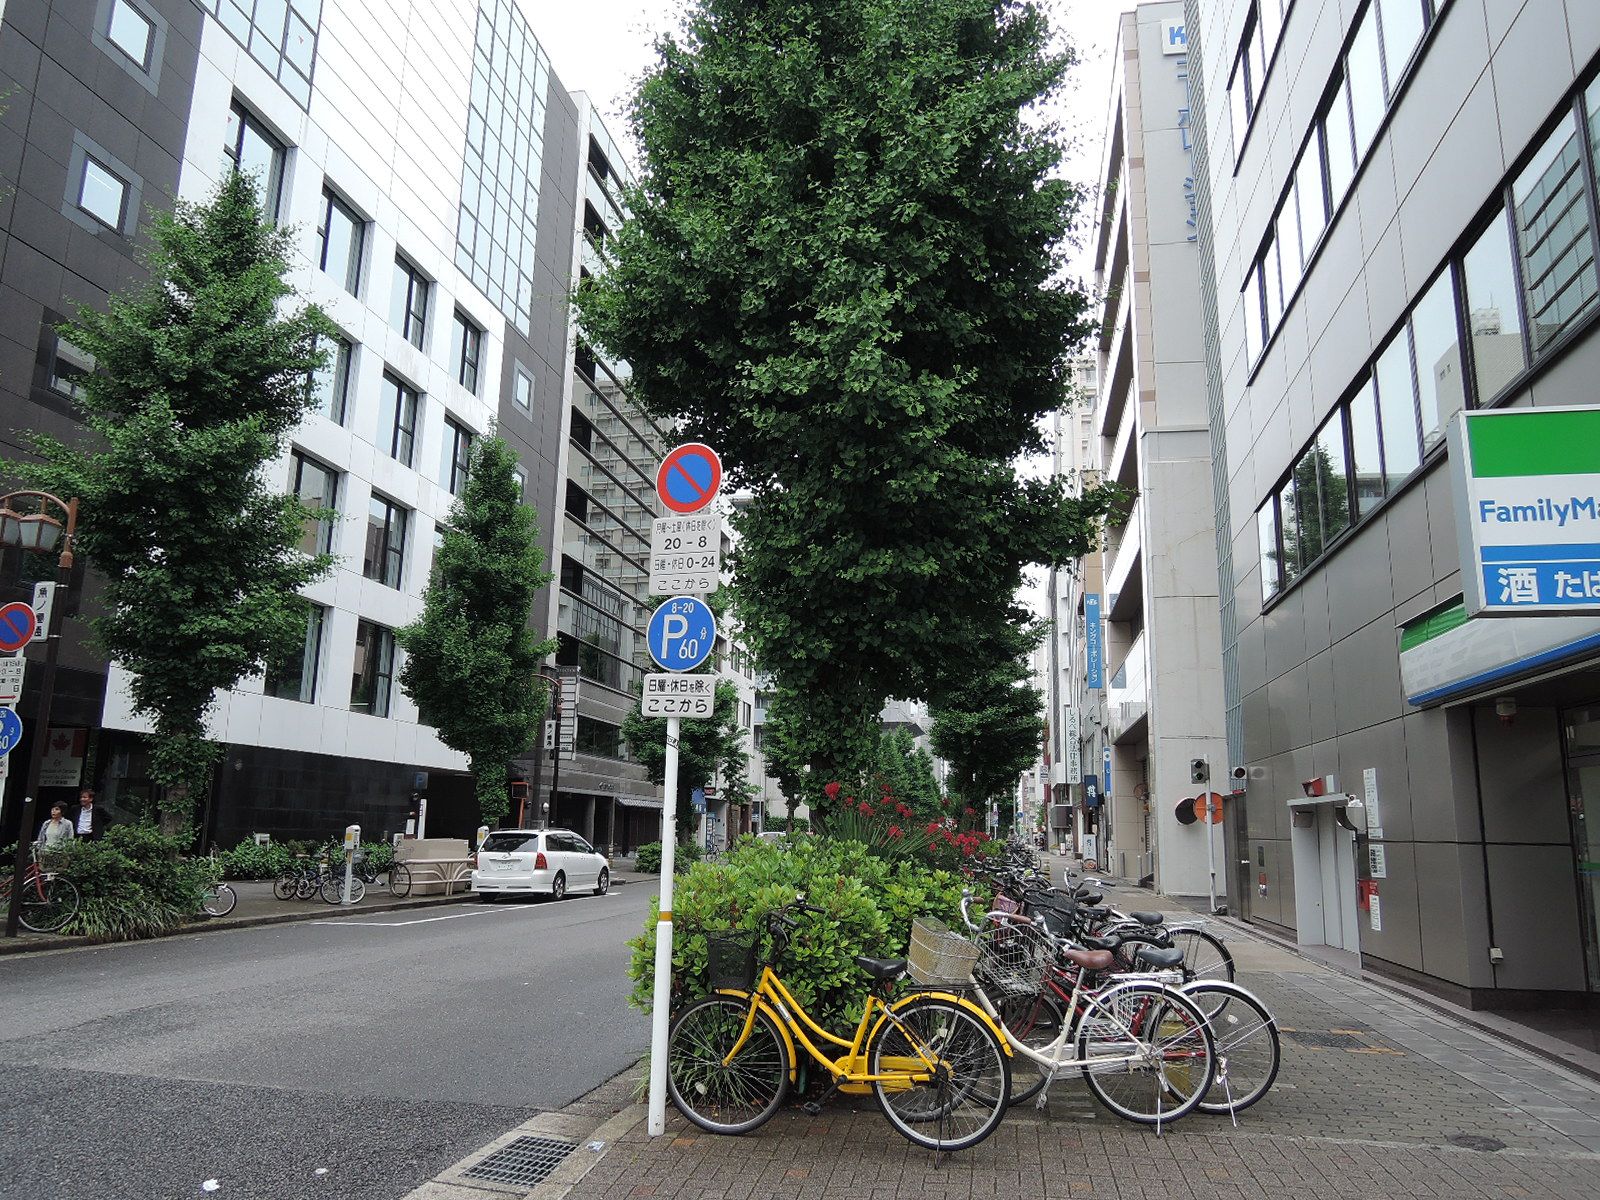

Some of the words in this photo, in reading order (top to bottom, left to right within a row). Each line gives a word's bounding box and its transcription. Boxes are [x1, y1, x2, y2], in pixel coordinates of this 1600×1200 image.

[1479, 496, 1600, 527] FamilyM
[657, 577, 710, 591] ここから
[1498, 567, 1539, 603] 酒
[671, 602, 694, 613] 8-20
[660, 613, 688, 659] P
[648, 679, 711, 693] 日曜・休日を除く
[648, 699, 708, 713] ここから
